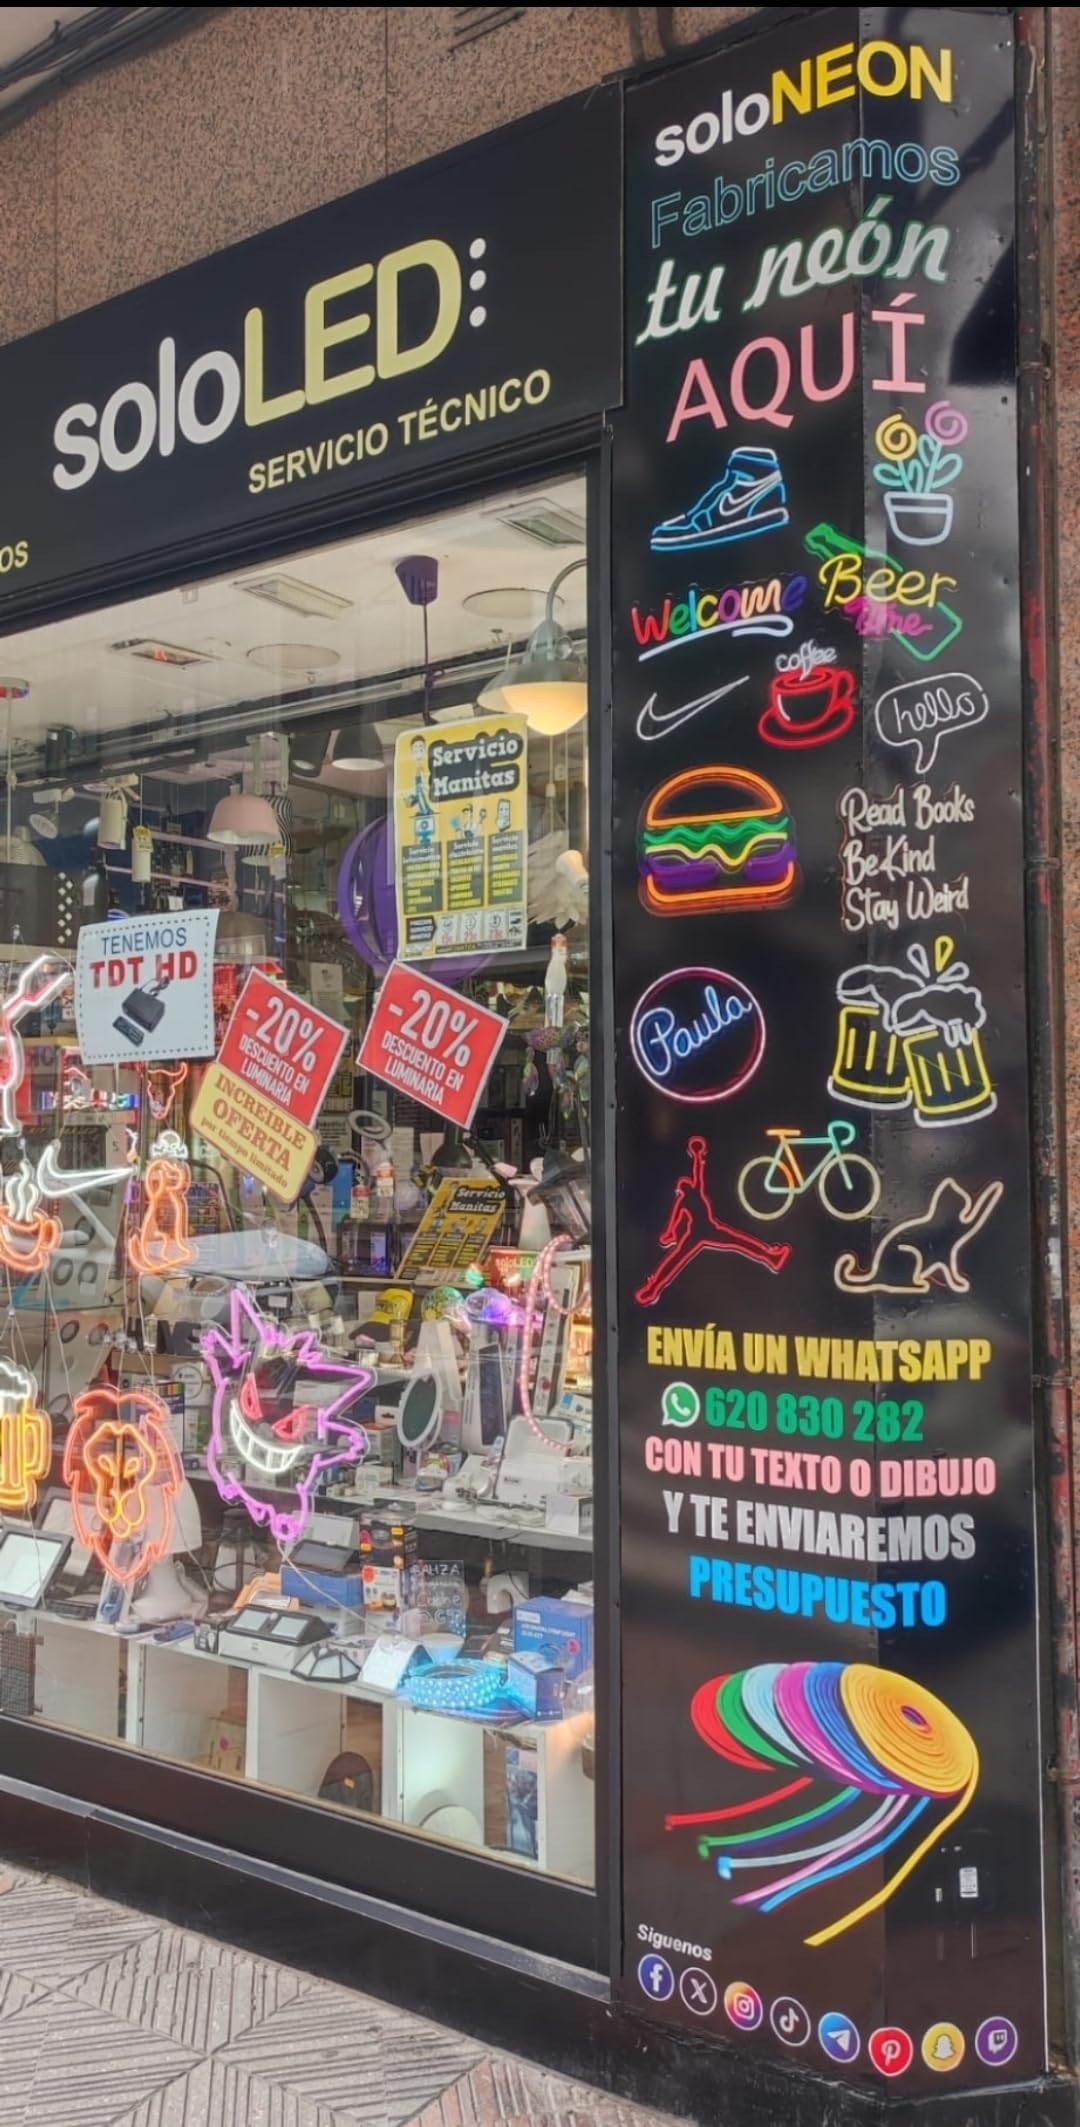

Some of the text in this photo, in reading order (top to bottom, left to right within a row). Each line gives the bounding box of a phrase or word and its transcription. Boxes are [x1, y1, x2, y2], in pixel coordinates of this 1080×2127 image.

[654, 40, 952, 167] soloNEON
[650, 138, 960, 248] Fabricamos
[635, 194, 950, 346] tu neón
[52, 239, 462, 491] soloLED
[666, 293, 926, 443] AQUÍ
[248, 368, 551, 494] SERVICIO TÉCNICO
[632, 575, 807, 645] Welcome
[819, 553, 958, 608] Beer
[776, 638, 836, 681] coffee
[894, 683, 976, 735] hello
[432, 737, 519, 767] Servicio
[433, 768, 516, 797] Manitas
[841, 783, 975, 834] Read Books
[845, 879, 969, 930] Stay Weird
[89, 950, 198, 989] TDT HD
[102, 927, 187, 955] TENEMOS
[246, 996, 325, 1072] -20%
[388, 988, 481, 1068] -20%
[637, 986, 752, 1076] Paula
[239, 1034, 311, 1095] DESCUENTO EN
[240, 1060, 293, 1107] LUMINARIA
[382, 1032, 465, 1092] DESCUENTO EN
[384, 1057, 446, 1105] LUMINARIA
[212, 1098, 291, 1172] OFERTA
[215, 1072, 306, 1150] INCREÍBLE
[201, 1117, 289, 1188] por tiempo limitado
[449, 1201, 498, 1212] Manitas
[456, 1187, 505, 1199] Servicio
[647, 1323, 991, 1382] ENVÍA UN WHATSAPP
[705, 1387, 924, 1442] 620 830 282
[645, 1436, 996, 1498] CON TU TEXTO O DIBUJO
[662, 1489, 976, 1562] Y TE ENVIAREMOS
[689, 1555, 947, 1628] PRESUPUESTO
